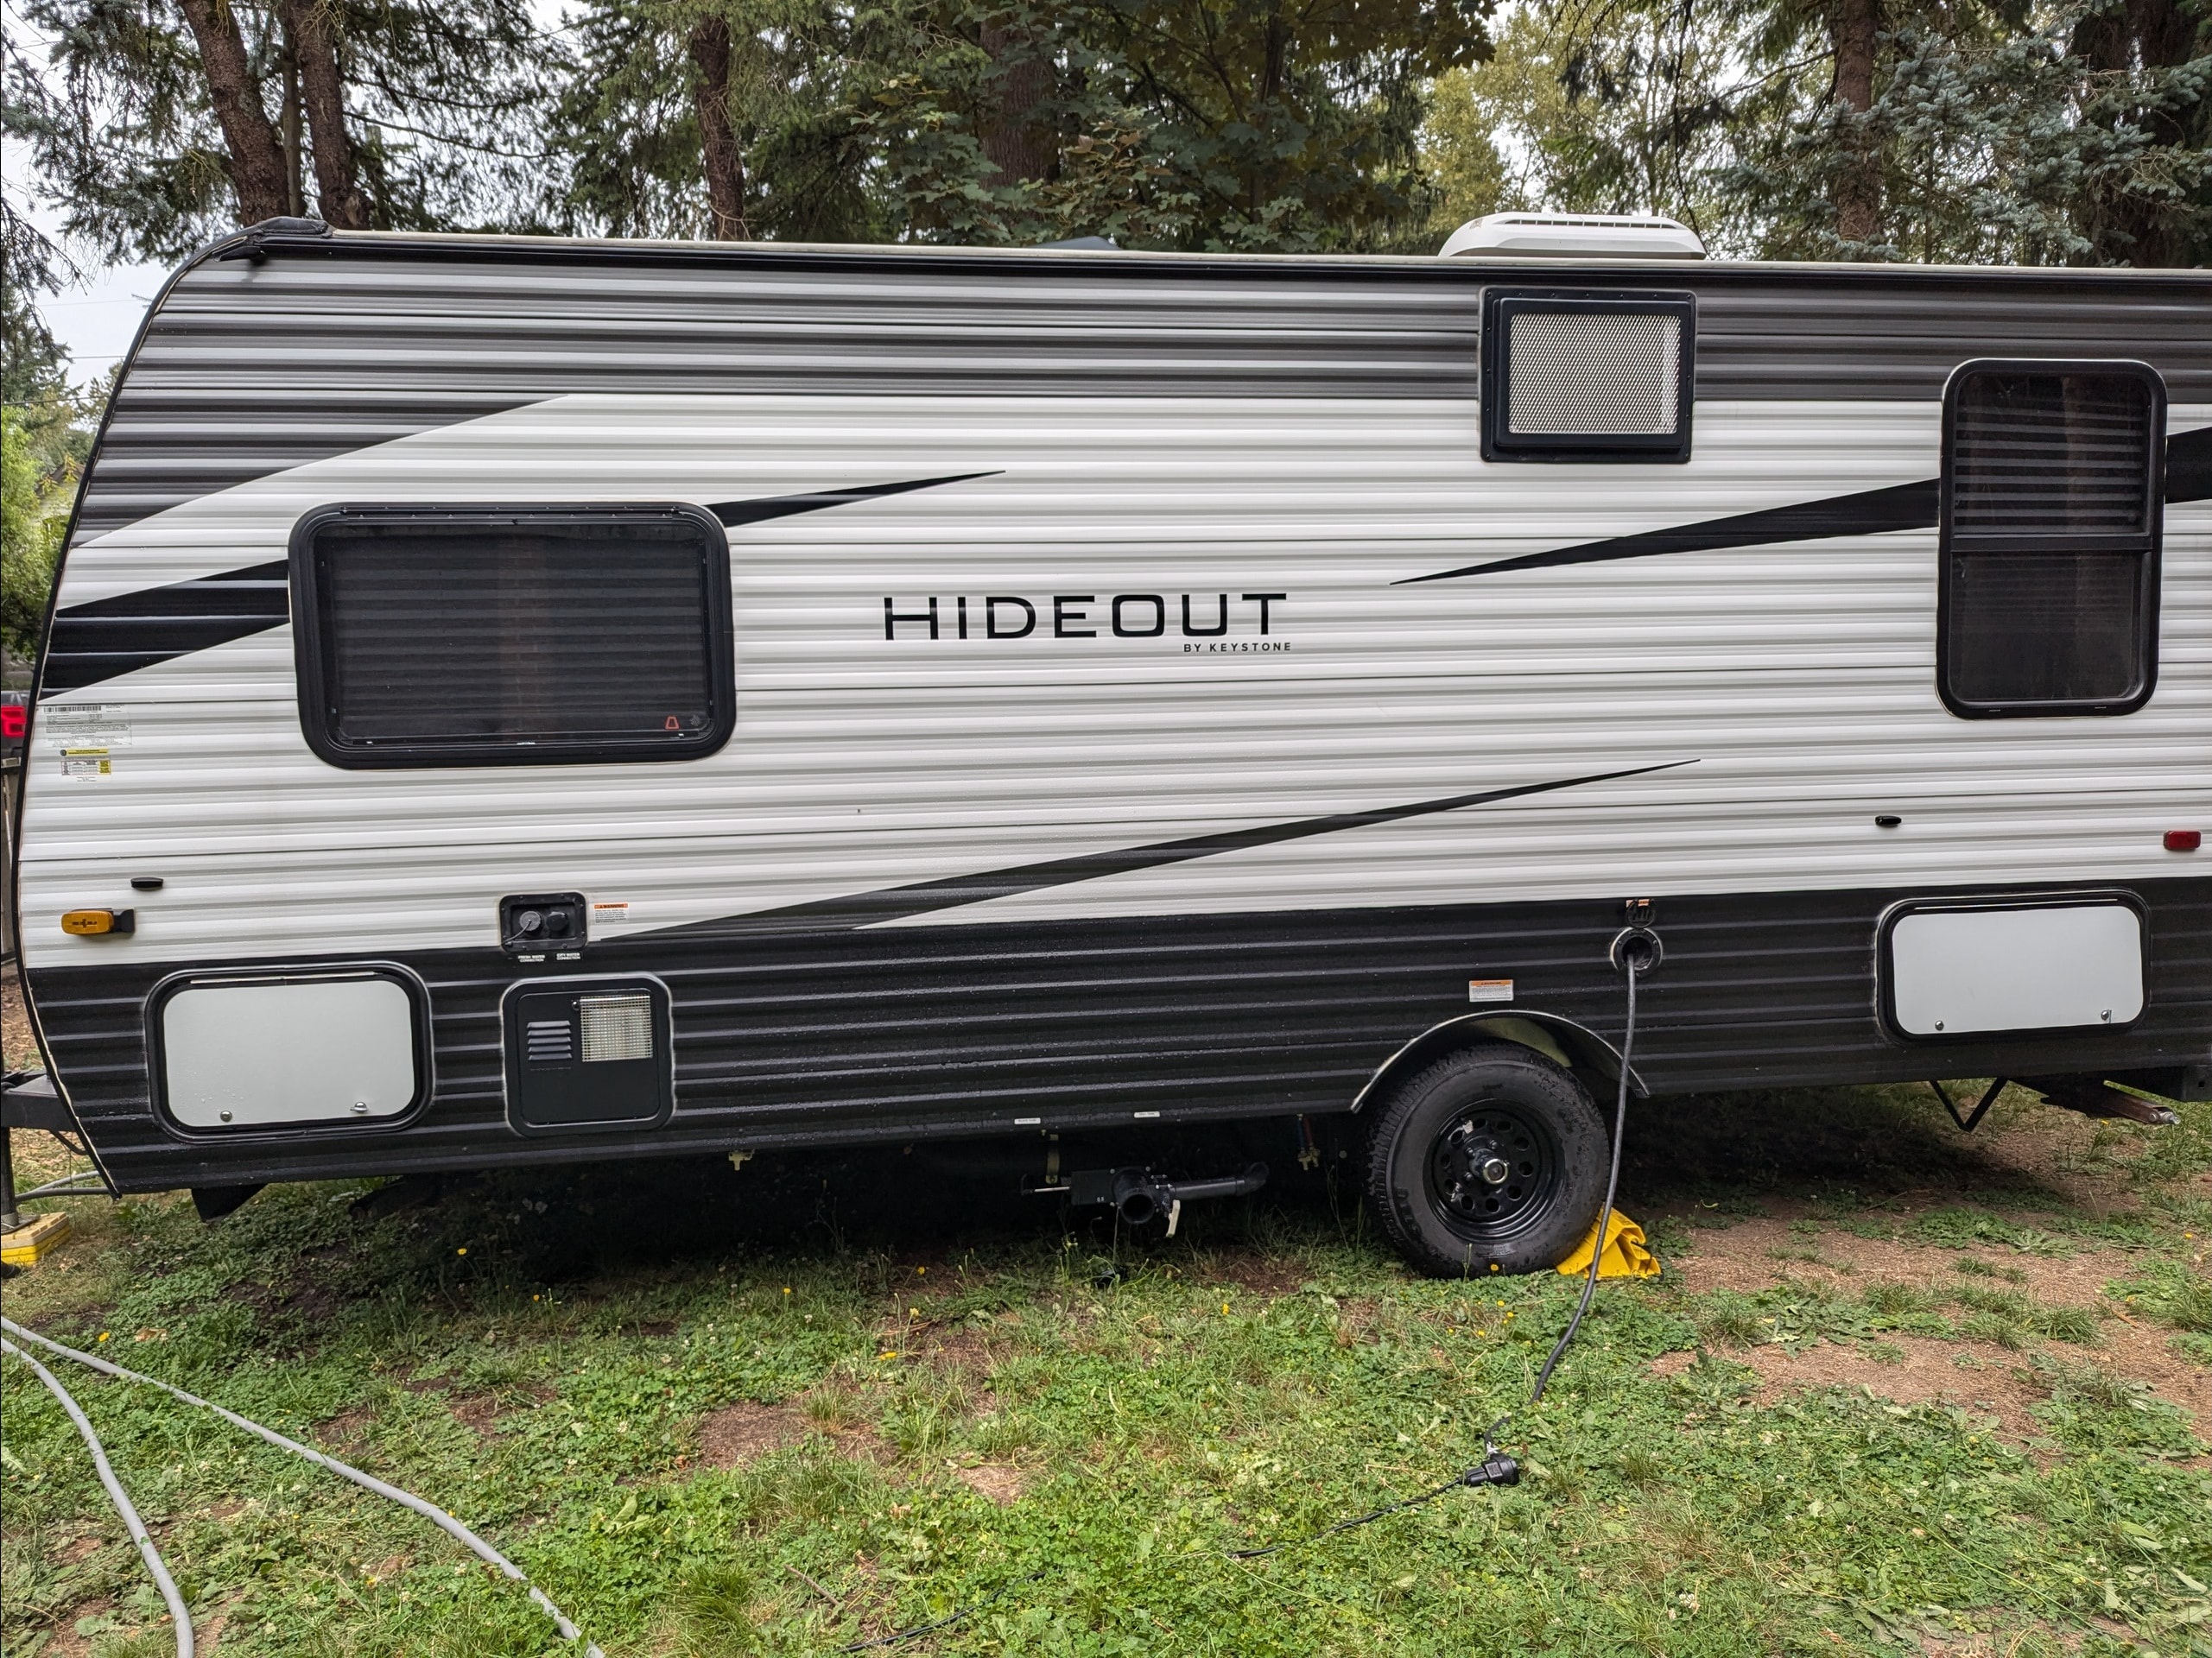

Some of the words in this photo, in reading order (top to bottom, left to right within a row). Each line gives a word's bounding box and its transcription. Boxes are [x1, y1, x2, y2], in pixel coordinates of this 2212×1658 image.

[884, 593, 1287, 640] HIDEOUT
[1184, 643, 1201, 652] BY
[1209, 642, 1292, 652] KEYSTONE
